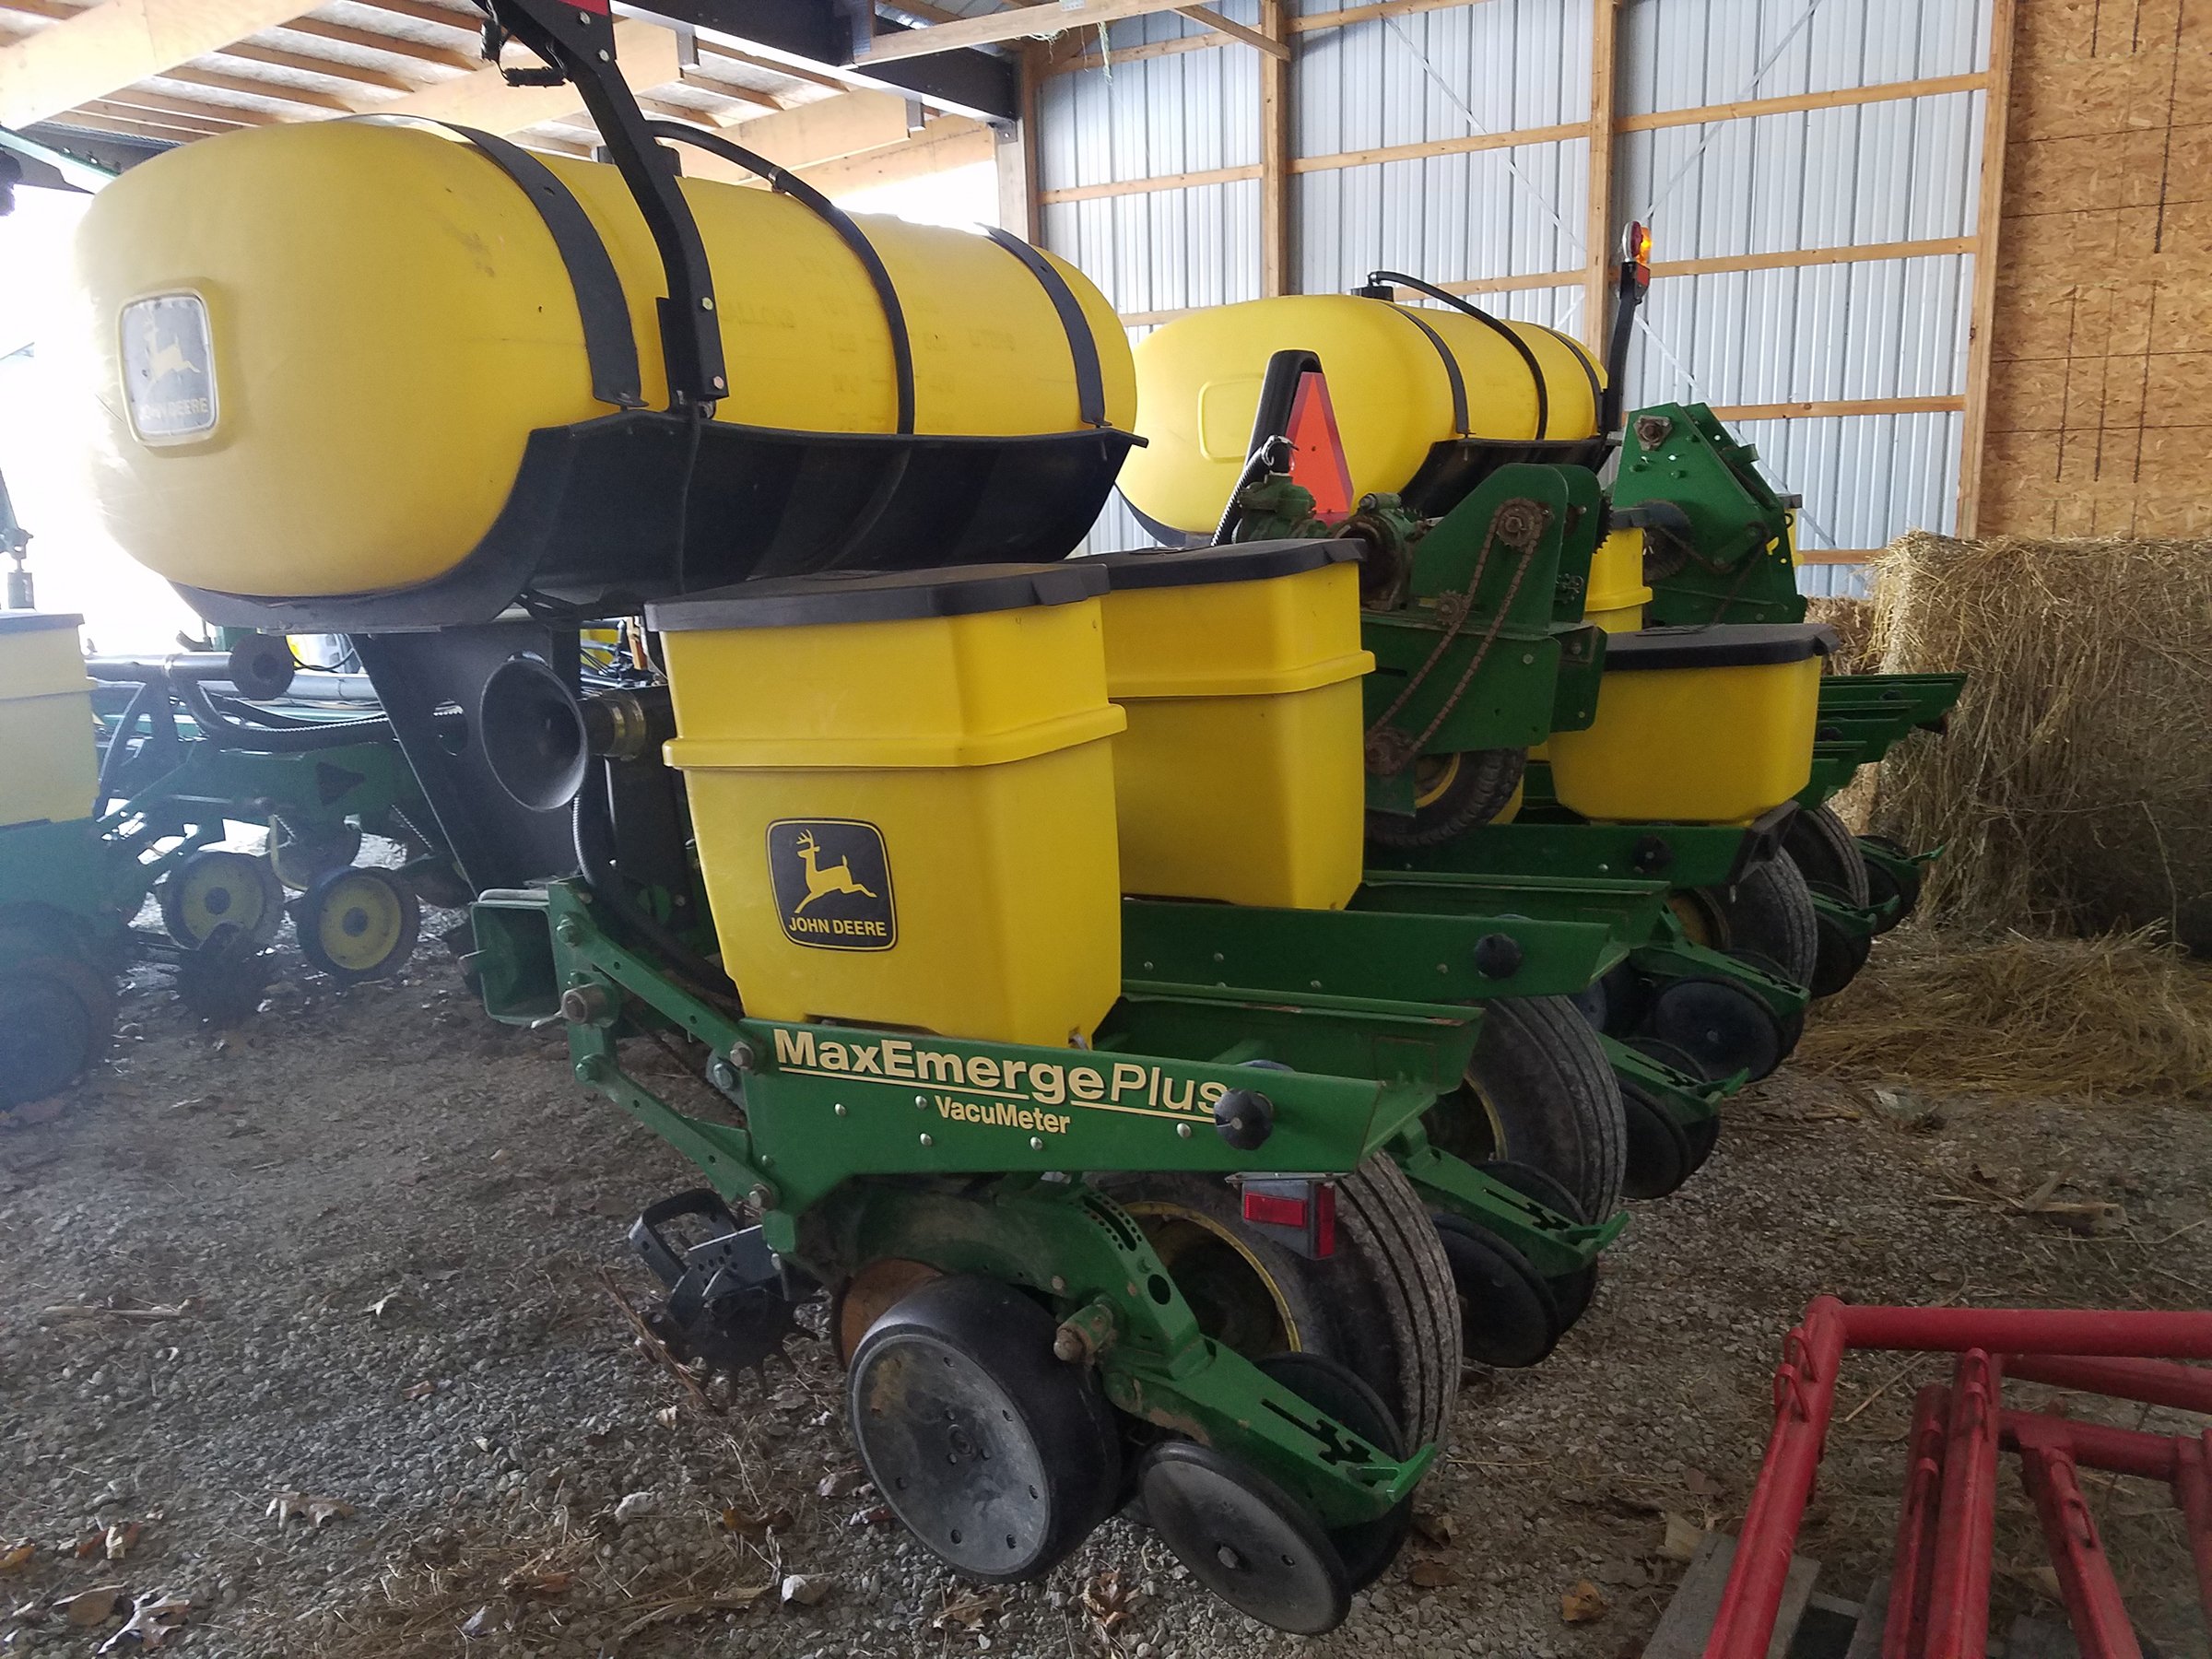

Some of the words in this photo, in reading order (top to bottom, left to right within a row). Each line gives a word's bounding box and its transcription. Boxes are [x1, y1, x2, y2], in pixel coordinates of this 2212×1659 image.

[789, 917, 830, 934] JOHN
[832, 919, 887, 936] DEERE
[935, 1096, 1071, 1134] VacuMeter
